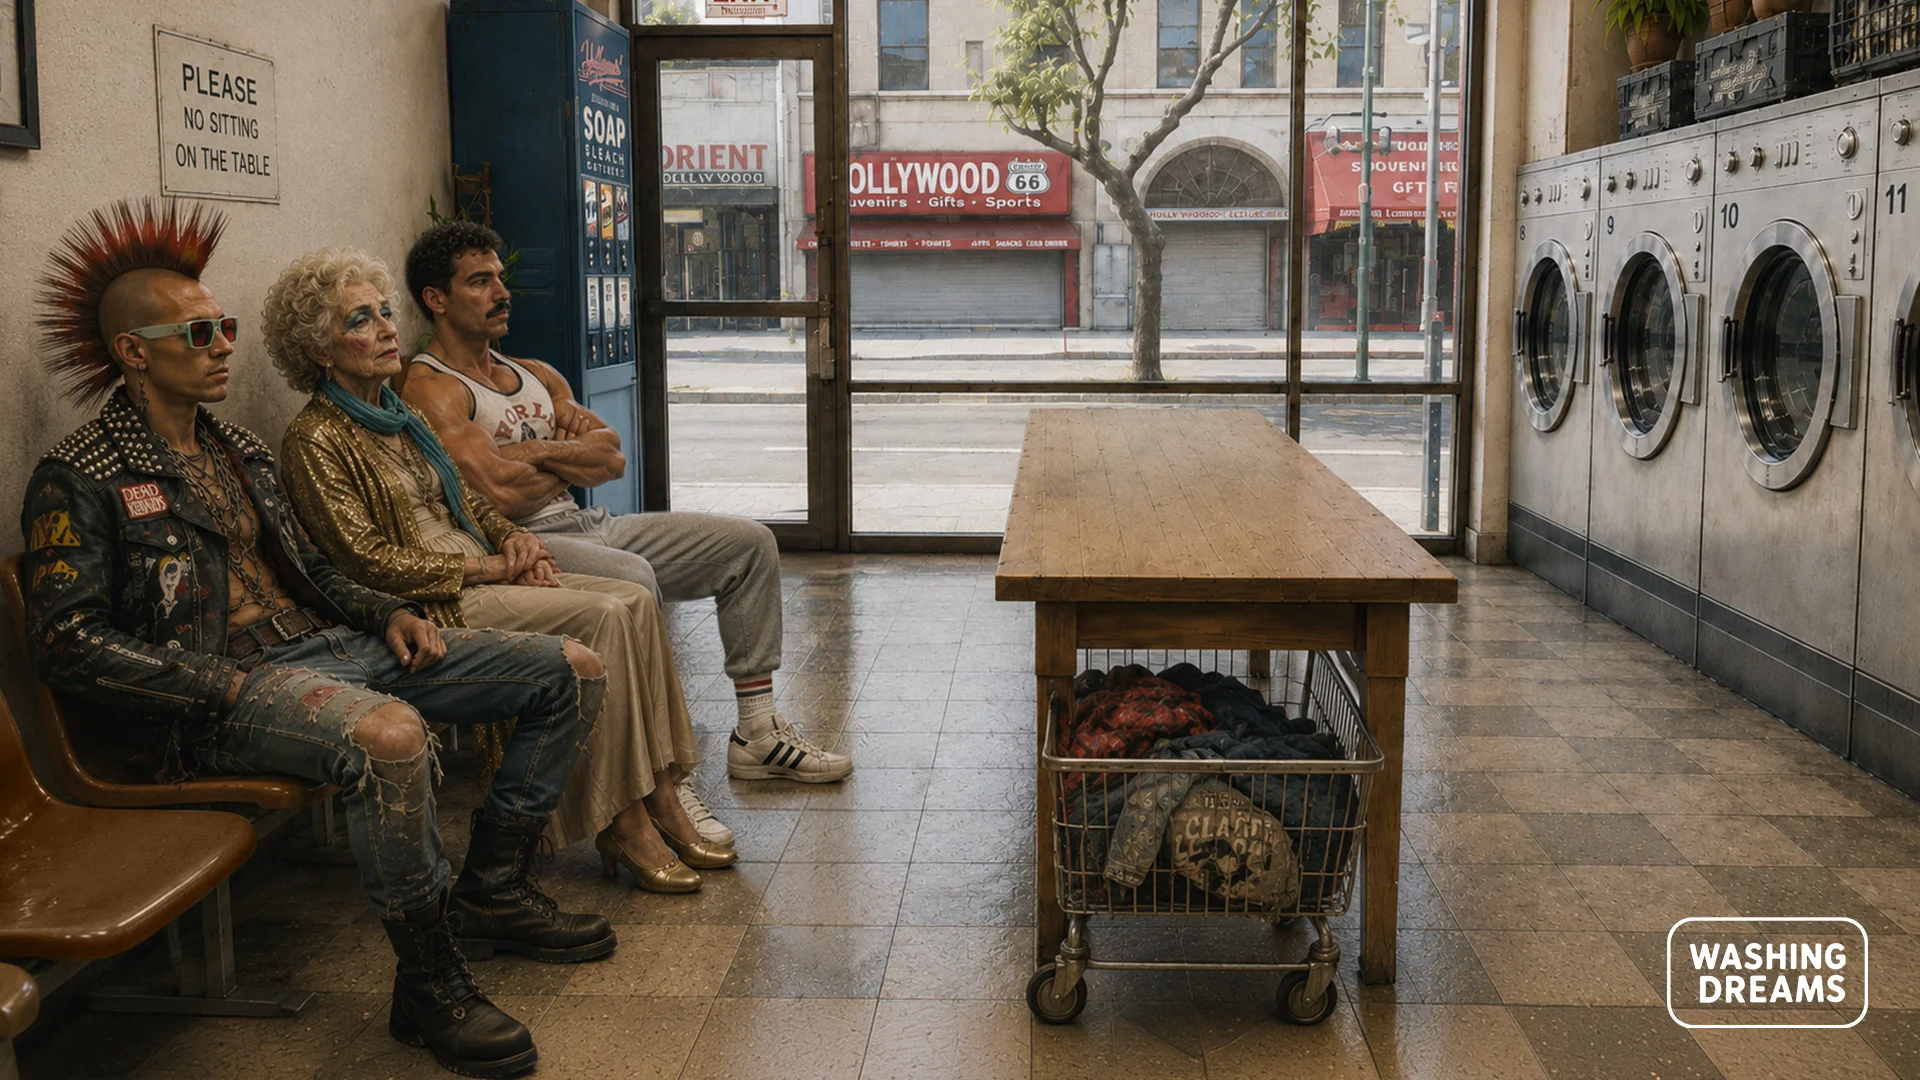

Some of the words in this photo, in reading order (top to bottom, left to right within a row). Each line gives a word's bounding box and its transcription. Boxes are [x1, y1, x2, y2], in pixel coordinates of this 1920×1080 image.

[182, 63, 257, 105] PLEASE
[184, 106, 204, 131] NO
[210, 112, 259, 139] SITTING
[583, 105, 626, 149] SOAP
[176, 143, 196, 168] ON
[201, 147, 228, 172] THE
[231, 151, 270, 176] TABLE
[1015, 174, 1040, 190] 66
[928, 196, 965, 208] Gifts
[985, 195, 1041, 210] Sports
[1885, 182, 1908, 215] 11
[1607, 215, 1615, 235] 9
[1720, 202, 1740, 229] 10
[1519, 224, 1526, 241] 8
